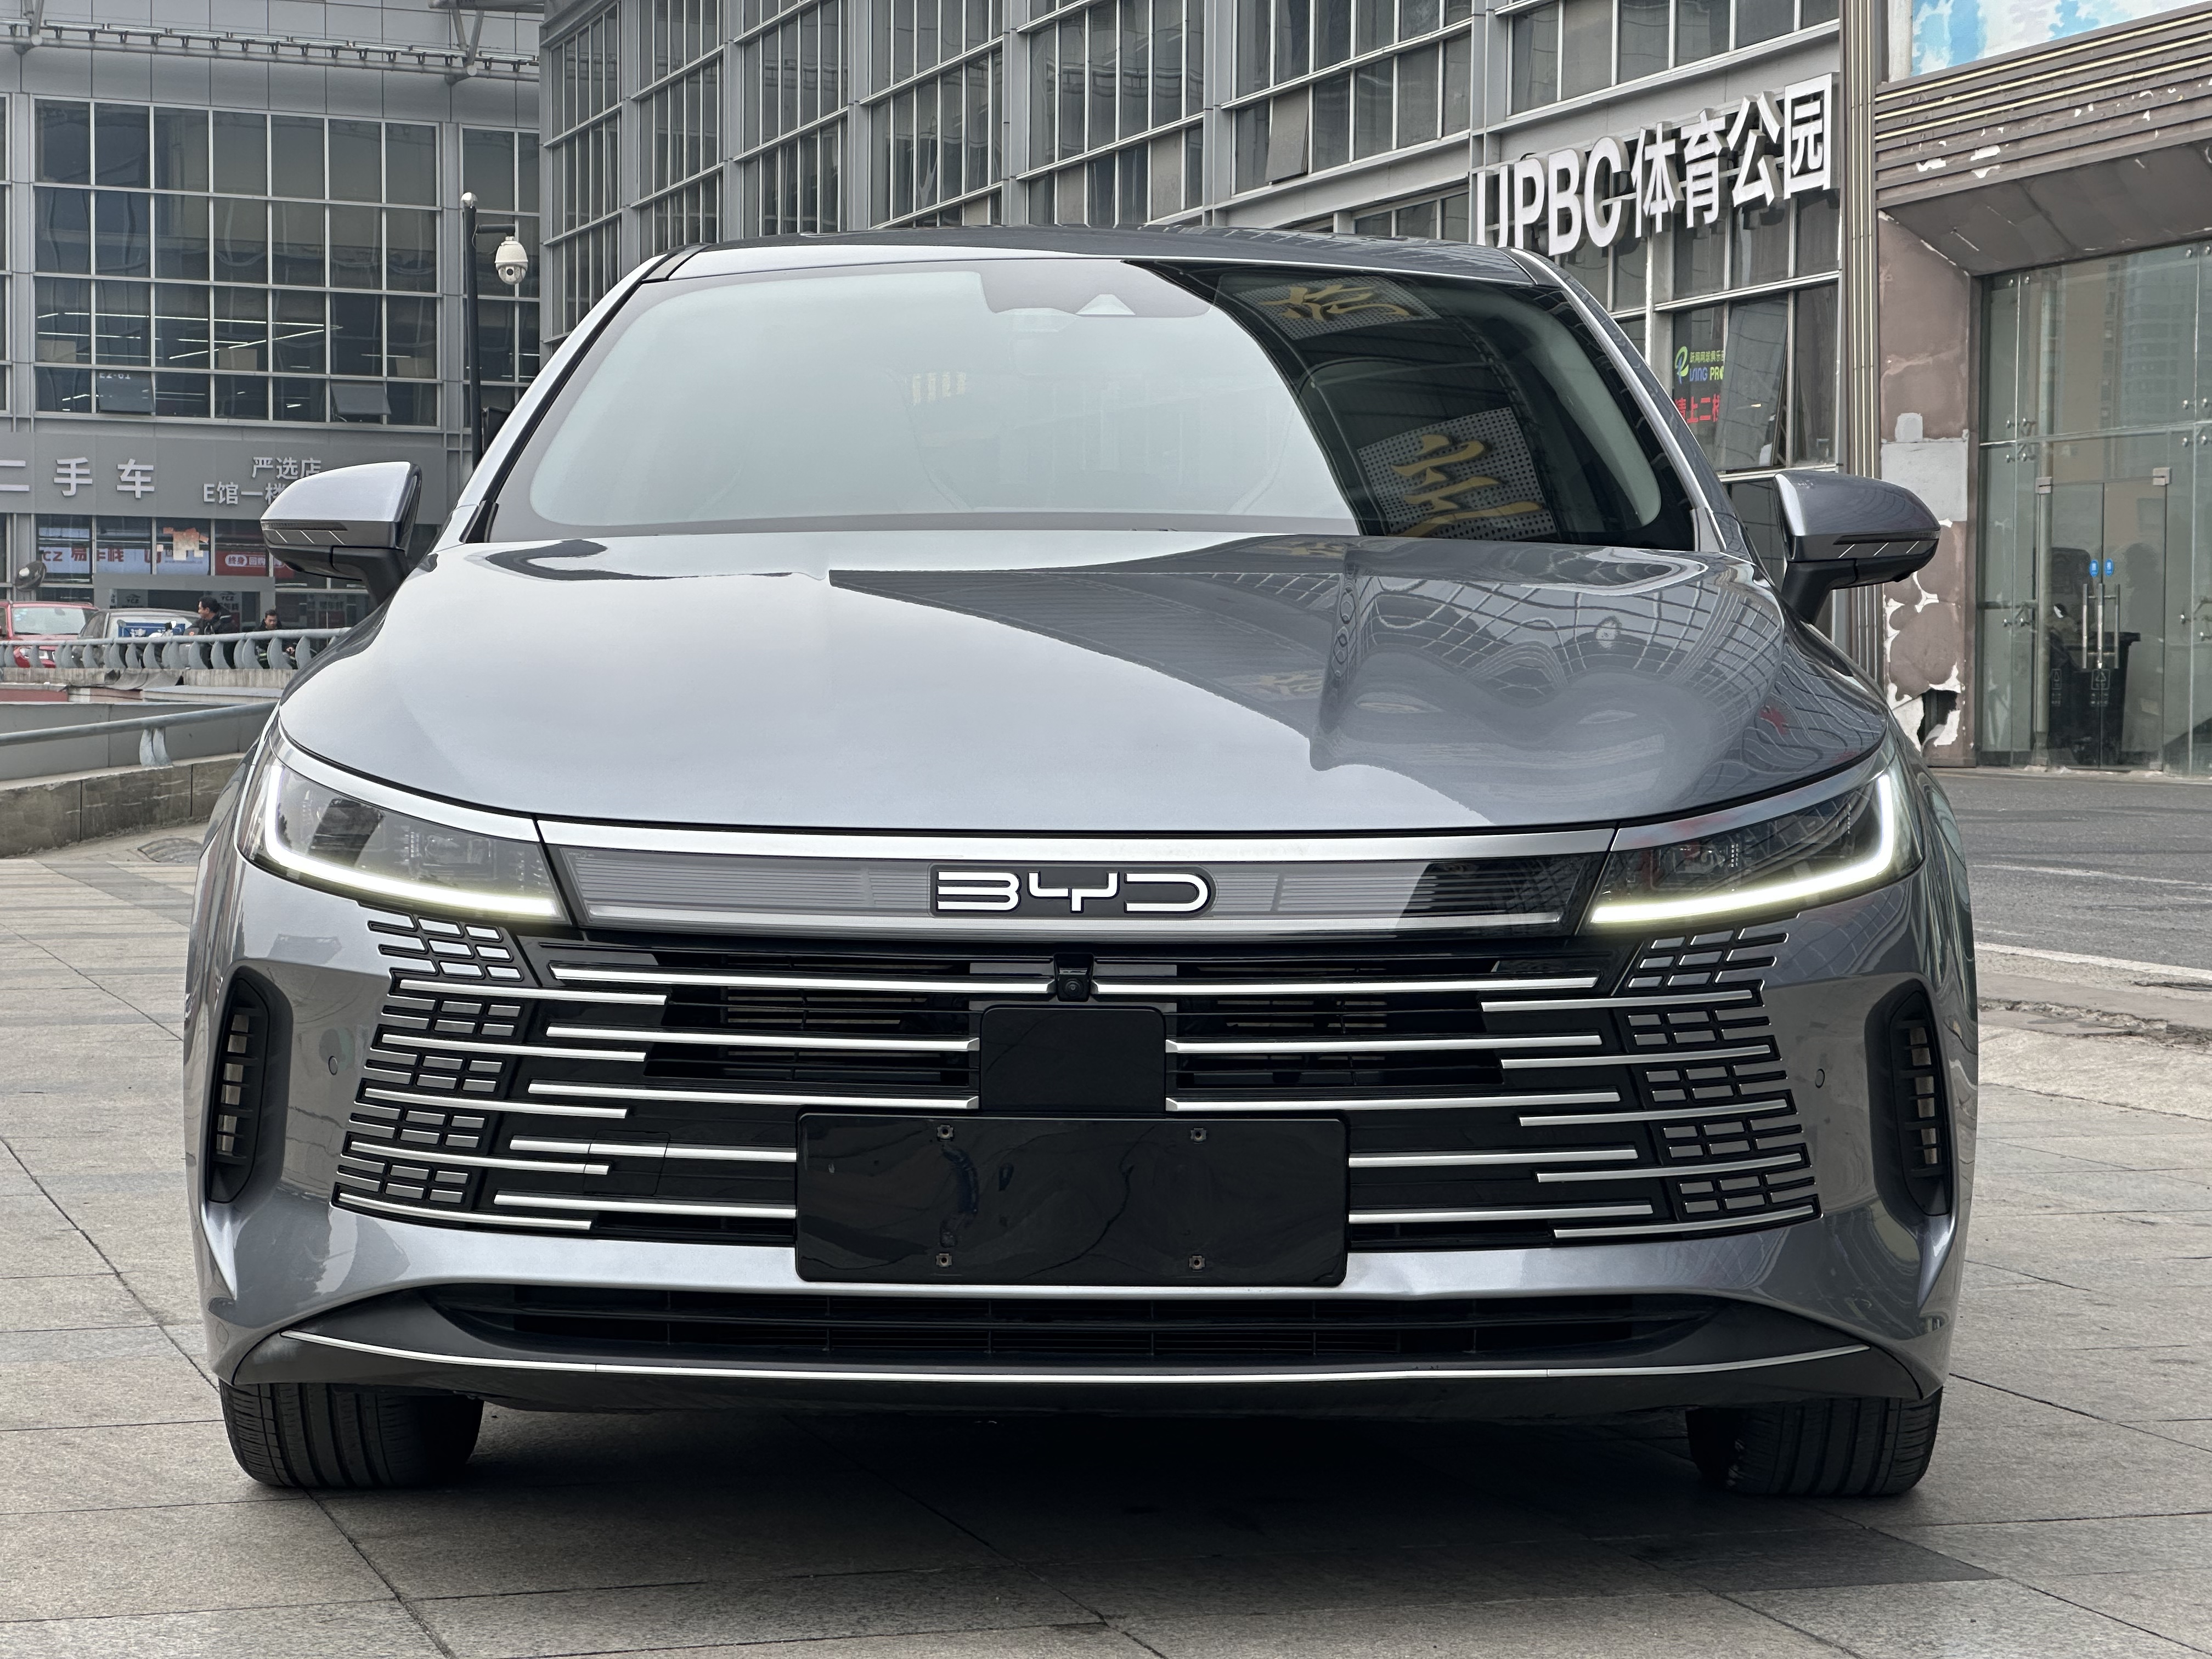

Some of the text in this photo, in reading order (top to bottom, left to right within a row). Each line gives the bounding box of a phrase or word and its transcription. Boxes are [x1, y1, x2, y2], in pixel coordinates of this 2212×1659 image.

[0, 456, 155, 499] 二手车
[252, 456, 321, 480] 严选店
[937, 871, 1210, 912] BYD
